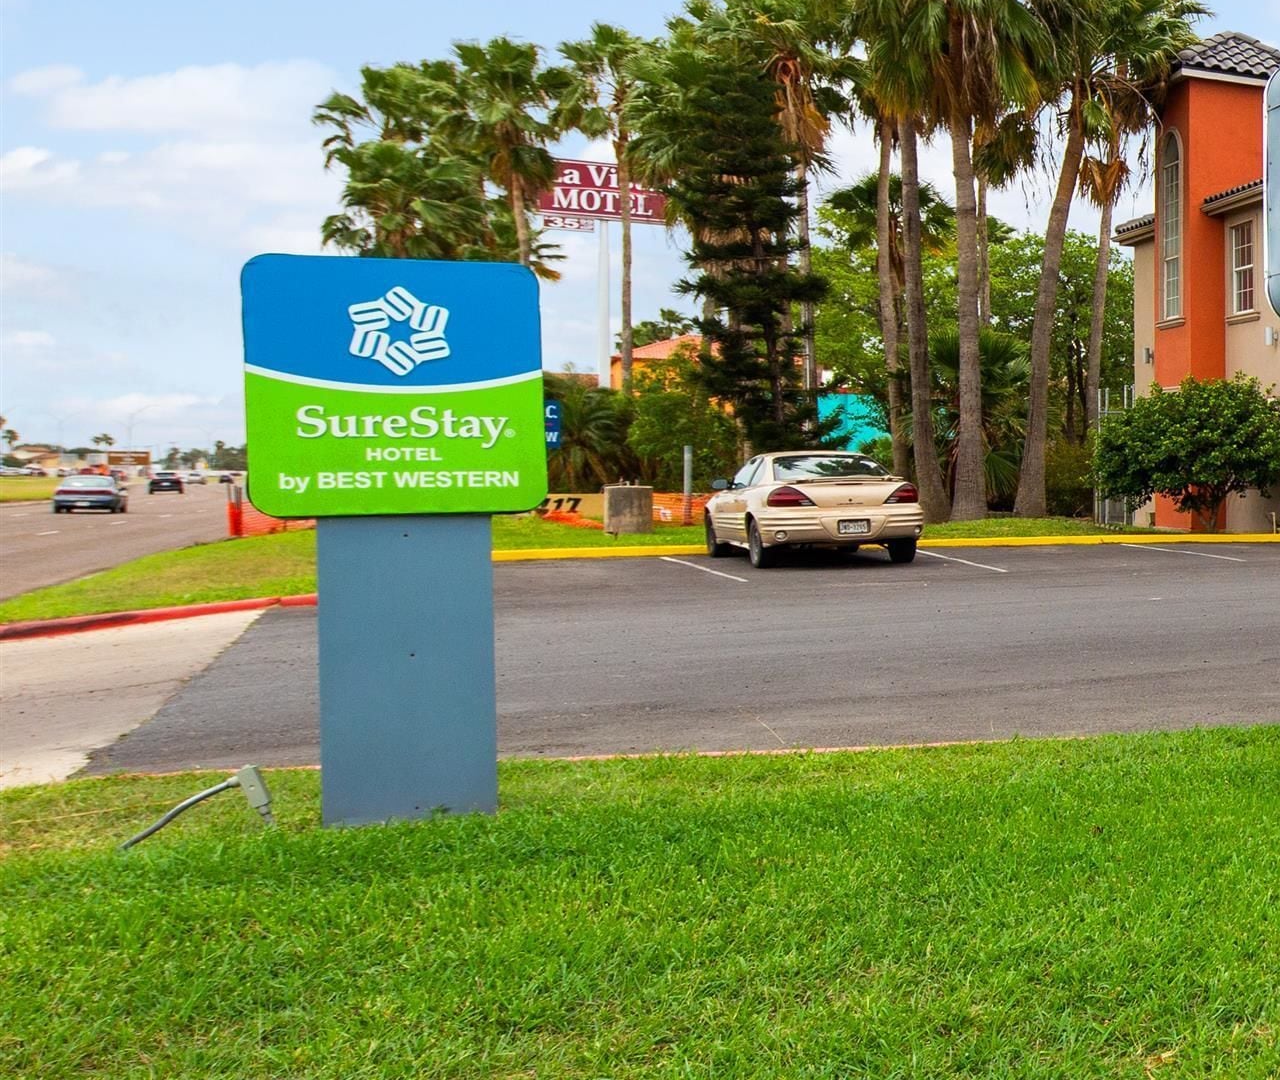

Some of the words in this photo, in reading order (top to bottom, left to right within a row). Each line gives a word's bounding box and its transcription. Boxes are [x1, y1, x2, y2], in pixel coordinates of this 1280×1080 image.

[365, 447, 443, 462] HOTEL
[279, 471, 311, 494] by
[317, 471, 388, 489] BEST
[393, 470, 520, 489] WESTERN
